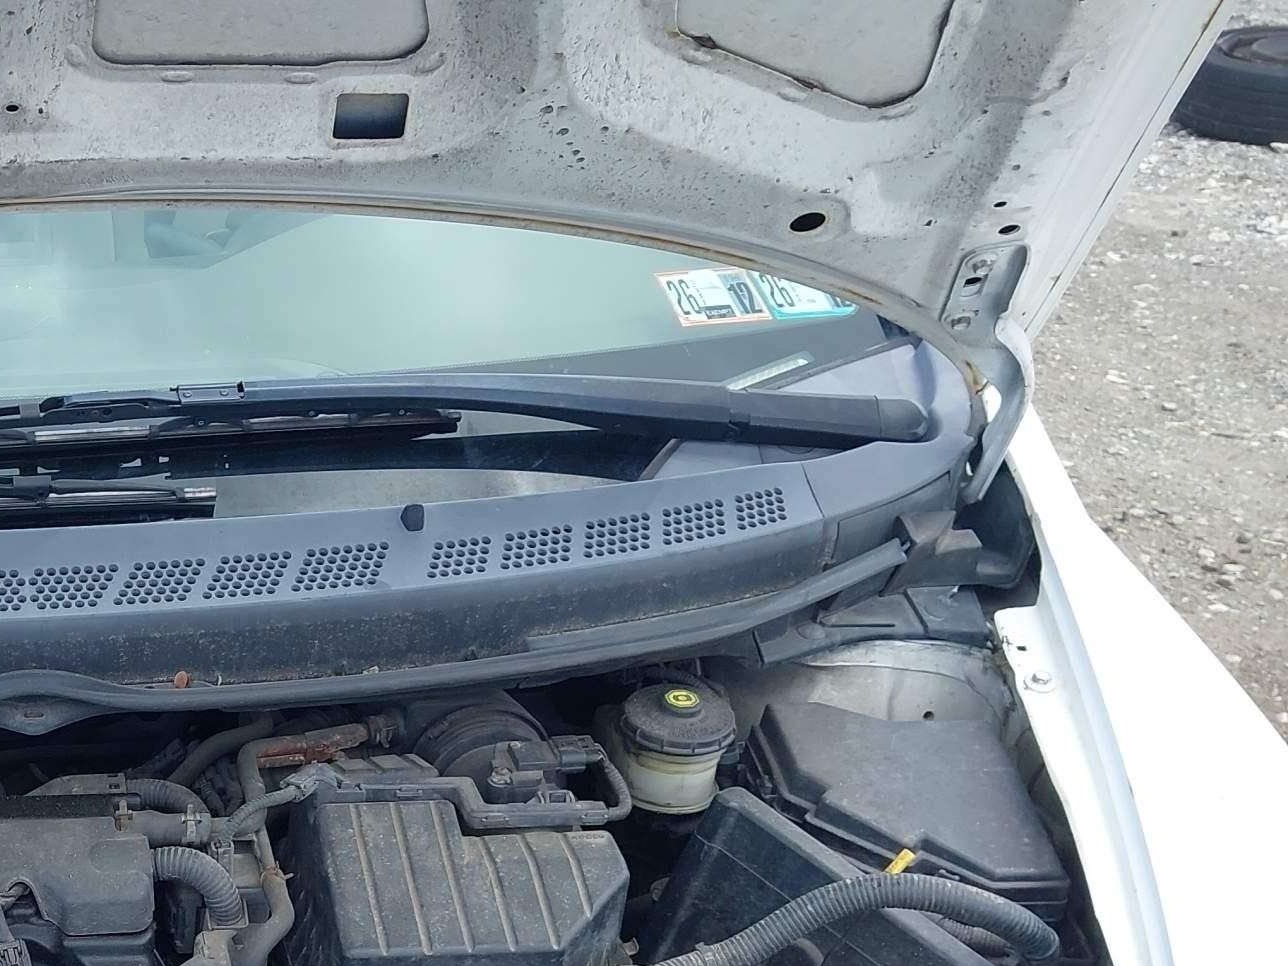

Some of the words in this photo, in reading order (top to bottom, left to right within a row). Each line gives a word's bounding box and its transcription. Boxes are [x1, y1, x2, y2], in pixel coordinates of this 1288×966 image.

[665, 279, 703, 317] 26
[727, 282, 763, 314] 12
[759, 274, 794, 307] 26
